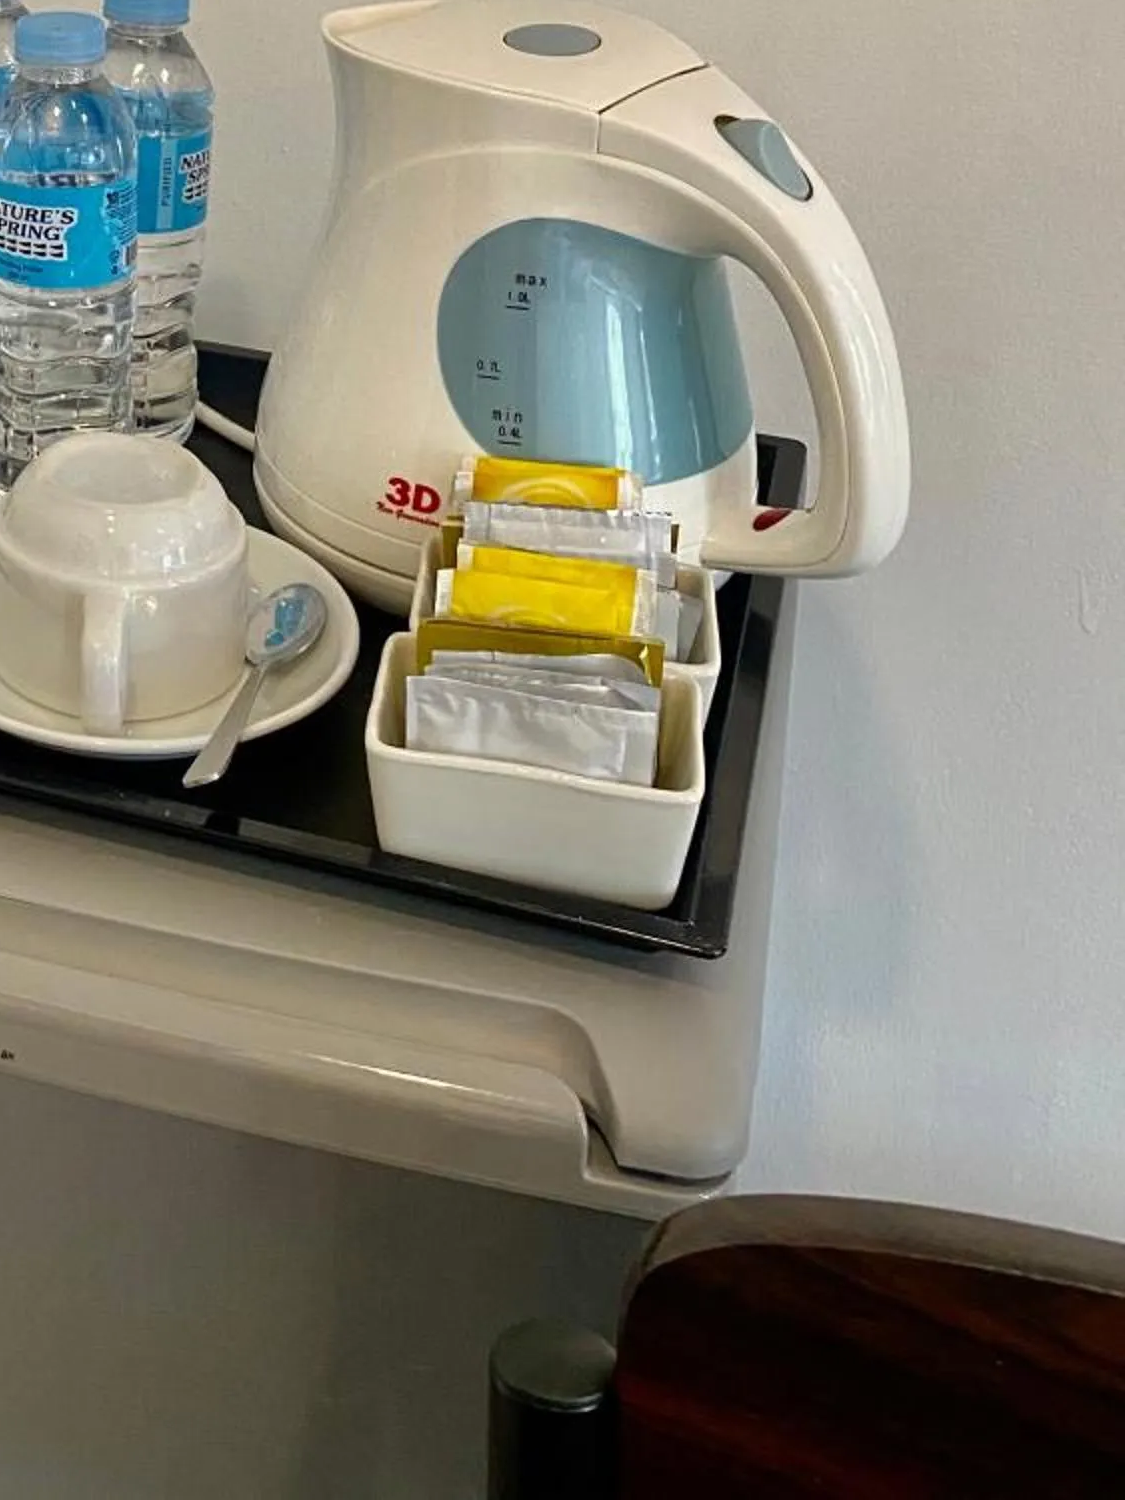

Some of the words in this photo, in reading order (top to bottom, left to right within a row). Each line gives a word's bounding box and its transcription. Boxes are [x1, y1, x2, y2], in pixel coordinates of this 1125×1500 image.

[515, 273, 548, 287] max
[492, 408, 523, 423] min
[385, 477, 441, 514] 3D
